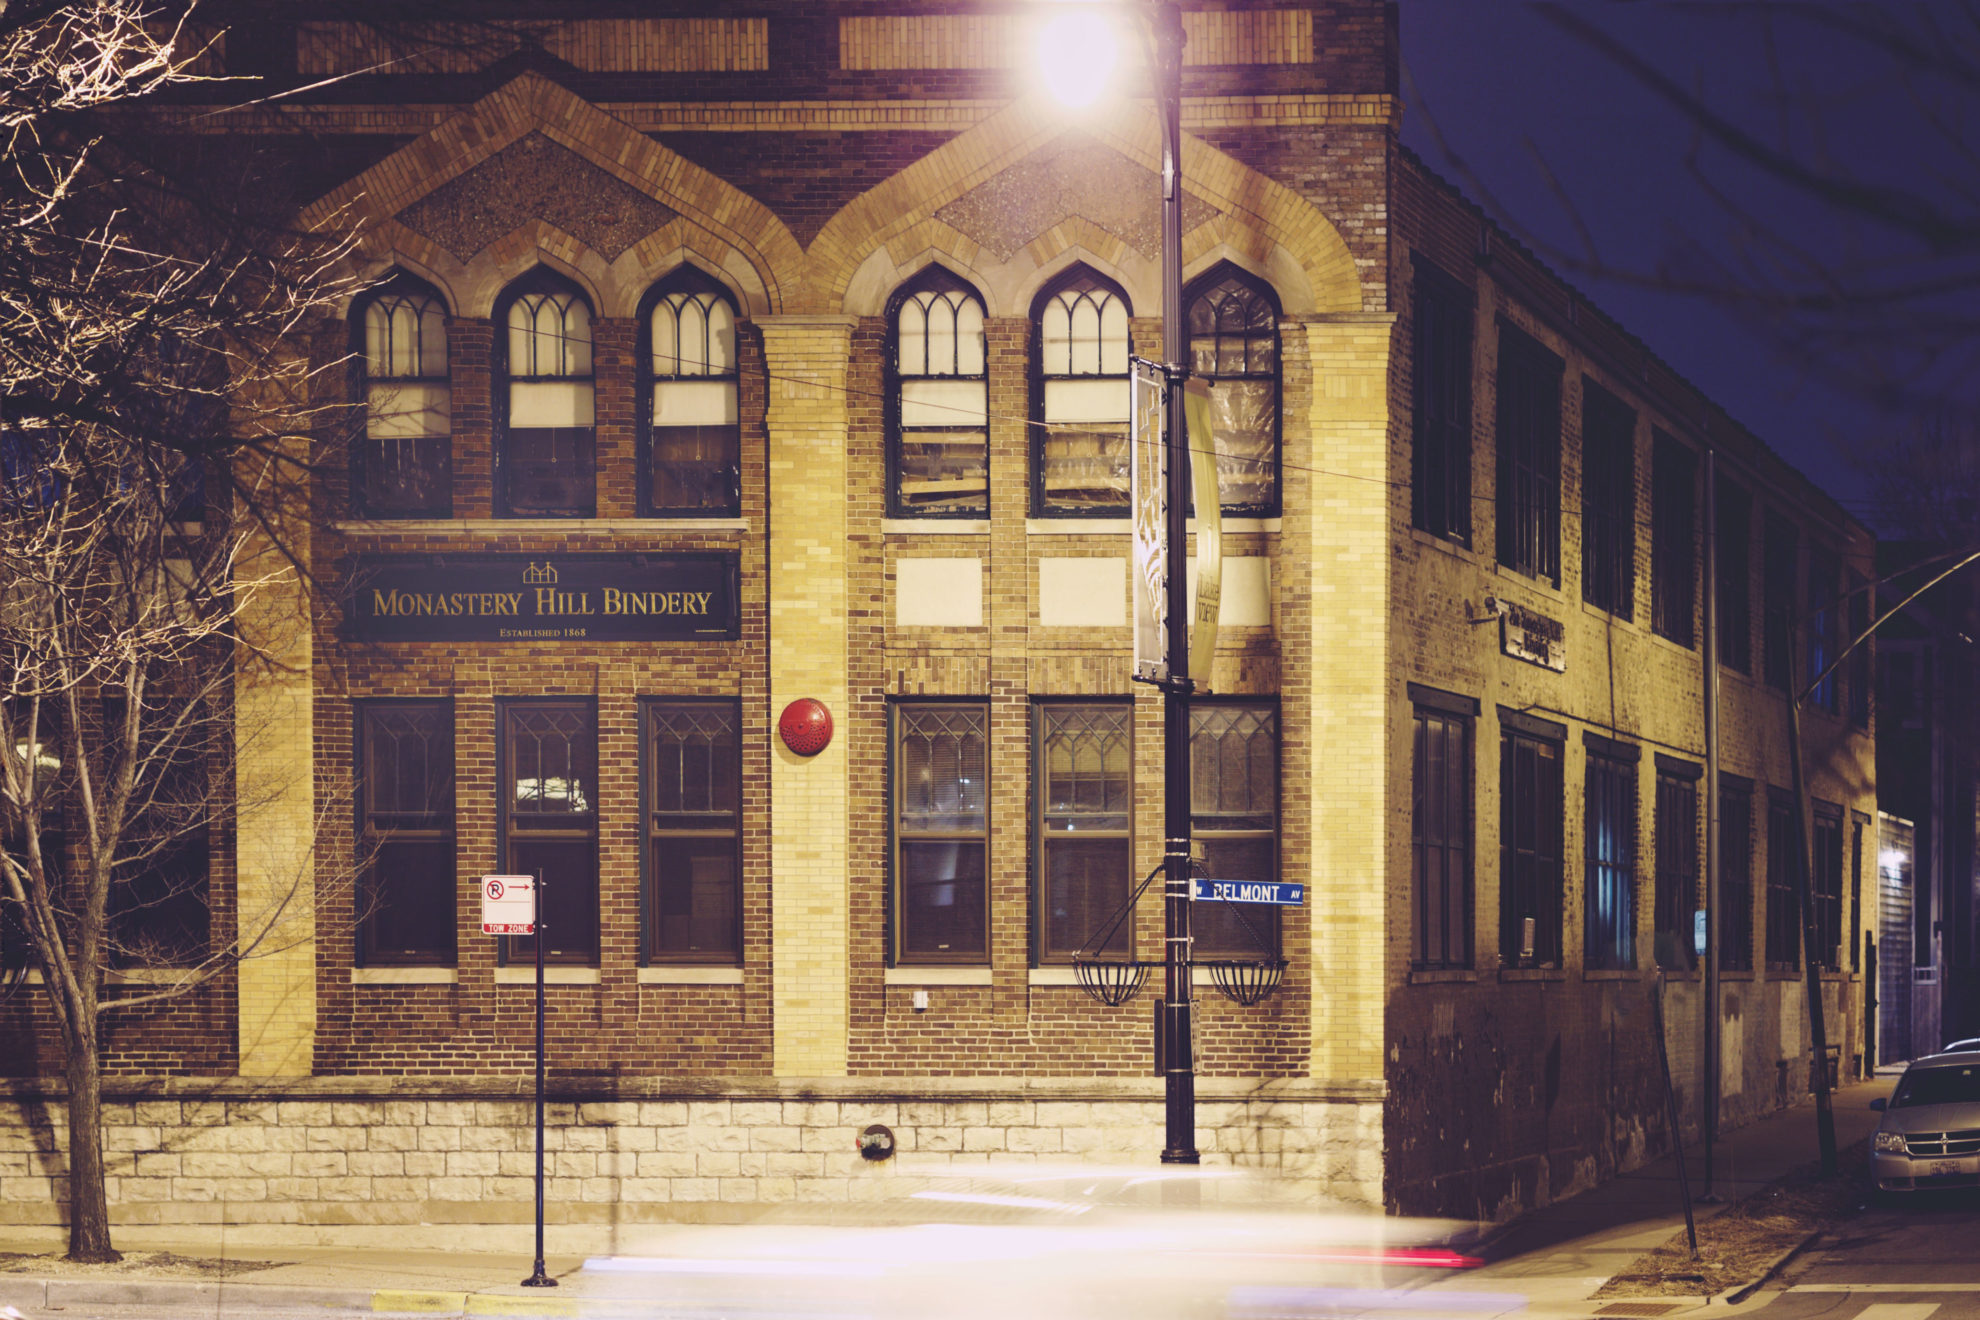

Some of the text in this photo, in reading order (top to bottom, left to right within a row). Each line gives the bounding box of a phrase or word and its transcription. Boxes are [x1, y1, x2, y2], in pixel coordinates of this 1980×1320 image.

[372, 587, 713, 617] MONASTERY HILL BINDERY
[500, 627, 587, 638] ESTABLISHED 1868
[1213, 883, 1280, 902] BELMONT
[1290, 890, 1301, 899] AV
[489, 924, 529, 933] TOW ZONE
